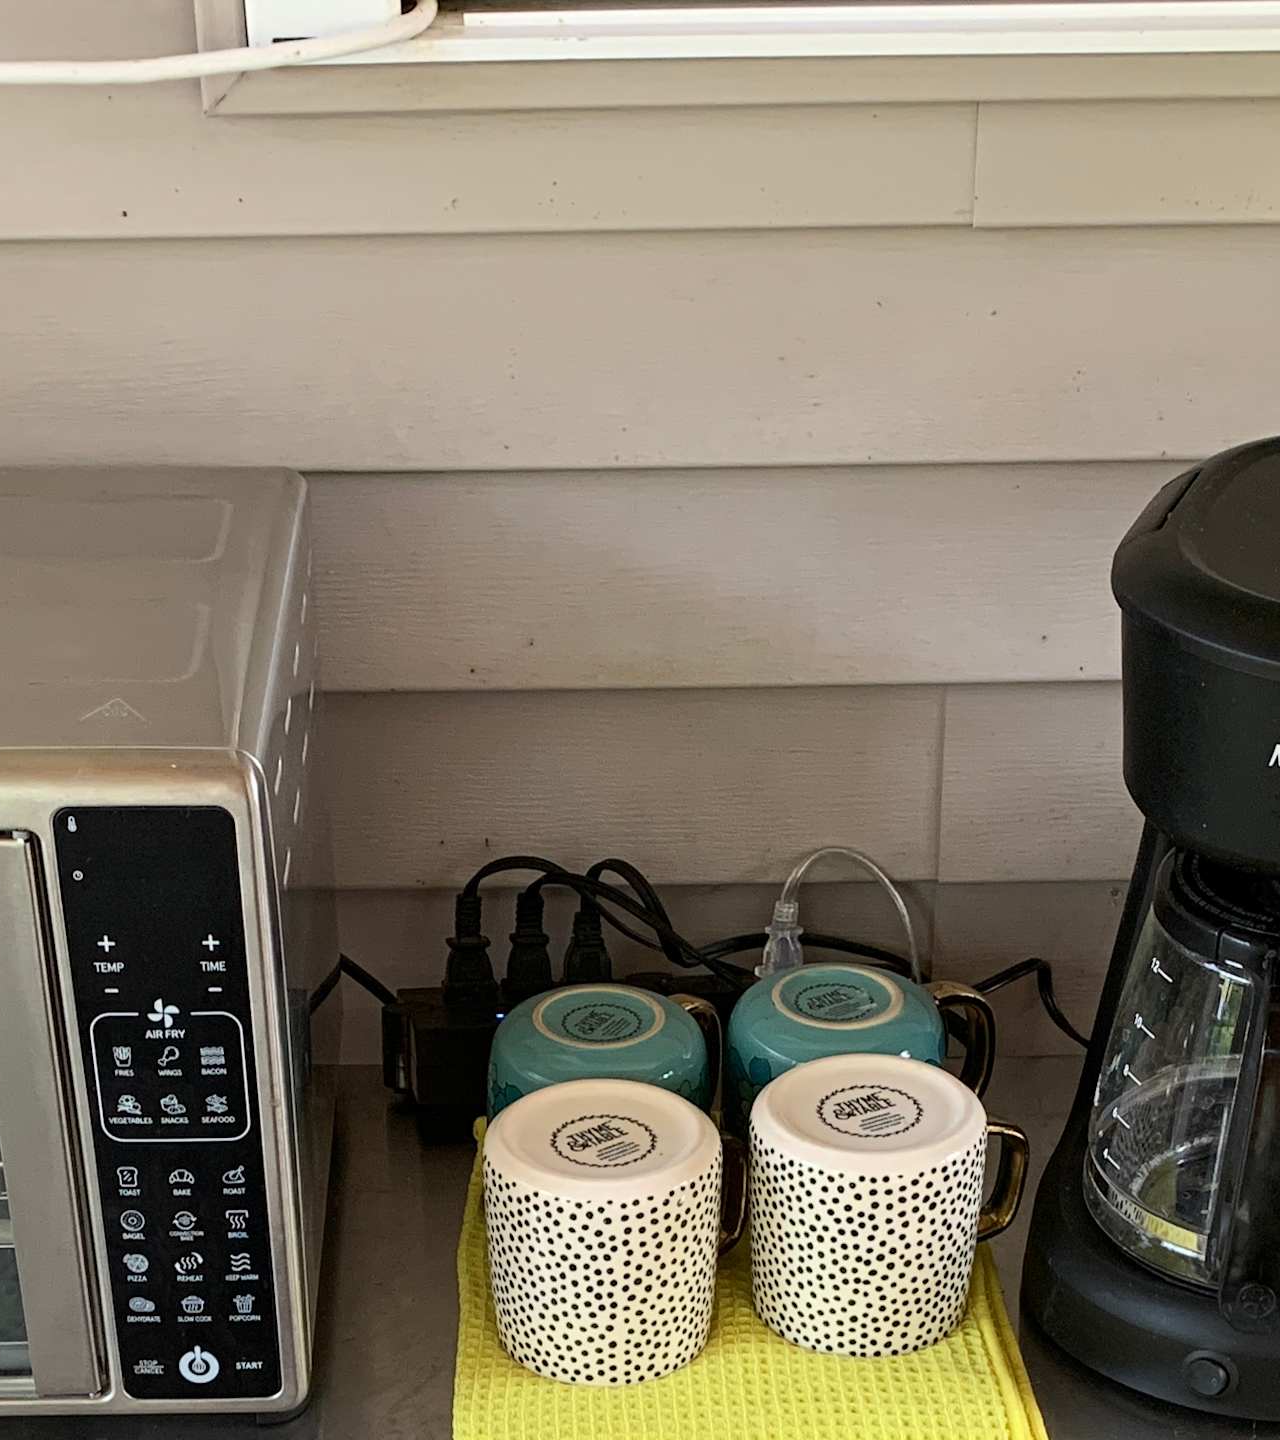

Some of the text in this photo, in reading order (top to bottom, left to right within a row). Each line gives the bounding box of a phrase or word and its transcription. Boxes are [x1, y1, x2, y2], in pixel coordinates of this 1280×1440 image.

[93, 962, 124, 973] TEMP
[200, 961, 226, 972] TIME
[145, 1029, 185, 1039] AIR FRY
[114, 1069, 134, 1077] FRIES
[158, 1069, 182, 1077] WINGS
[201, 1067, 227, 1075] BACON
[108, 1117, 153, 1125] VEGETABLES
[161, 1117, 189, 1125] SNACKS
[201, 1116, 235, 1124] SEAFOOD
[122, 1232, 145, 1240] BAGEL
[228, 1231, 249, 1239] BROIL
[127, 1315, 161, 1323] DEHYDRATE
[195, 1315, 212, 1323] COOK
[229, 1314, 261, 1322] POPCORN
[235, 1361, 263, 1371] START
[134, 1366, 164, 1375] CANCEL
